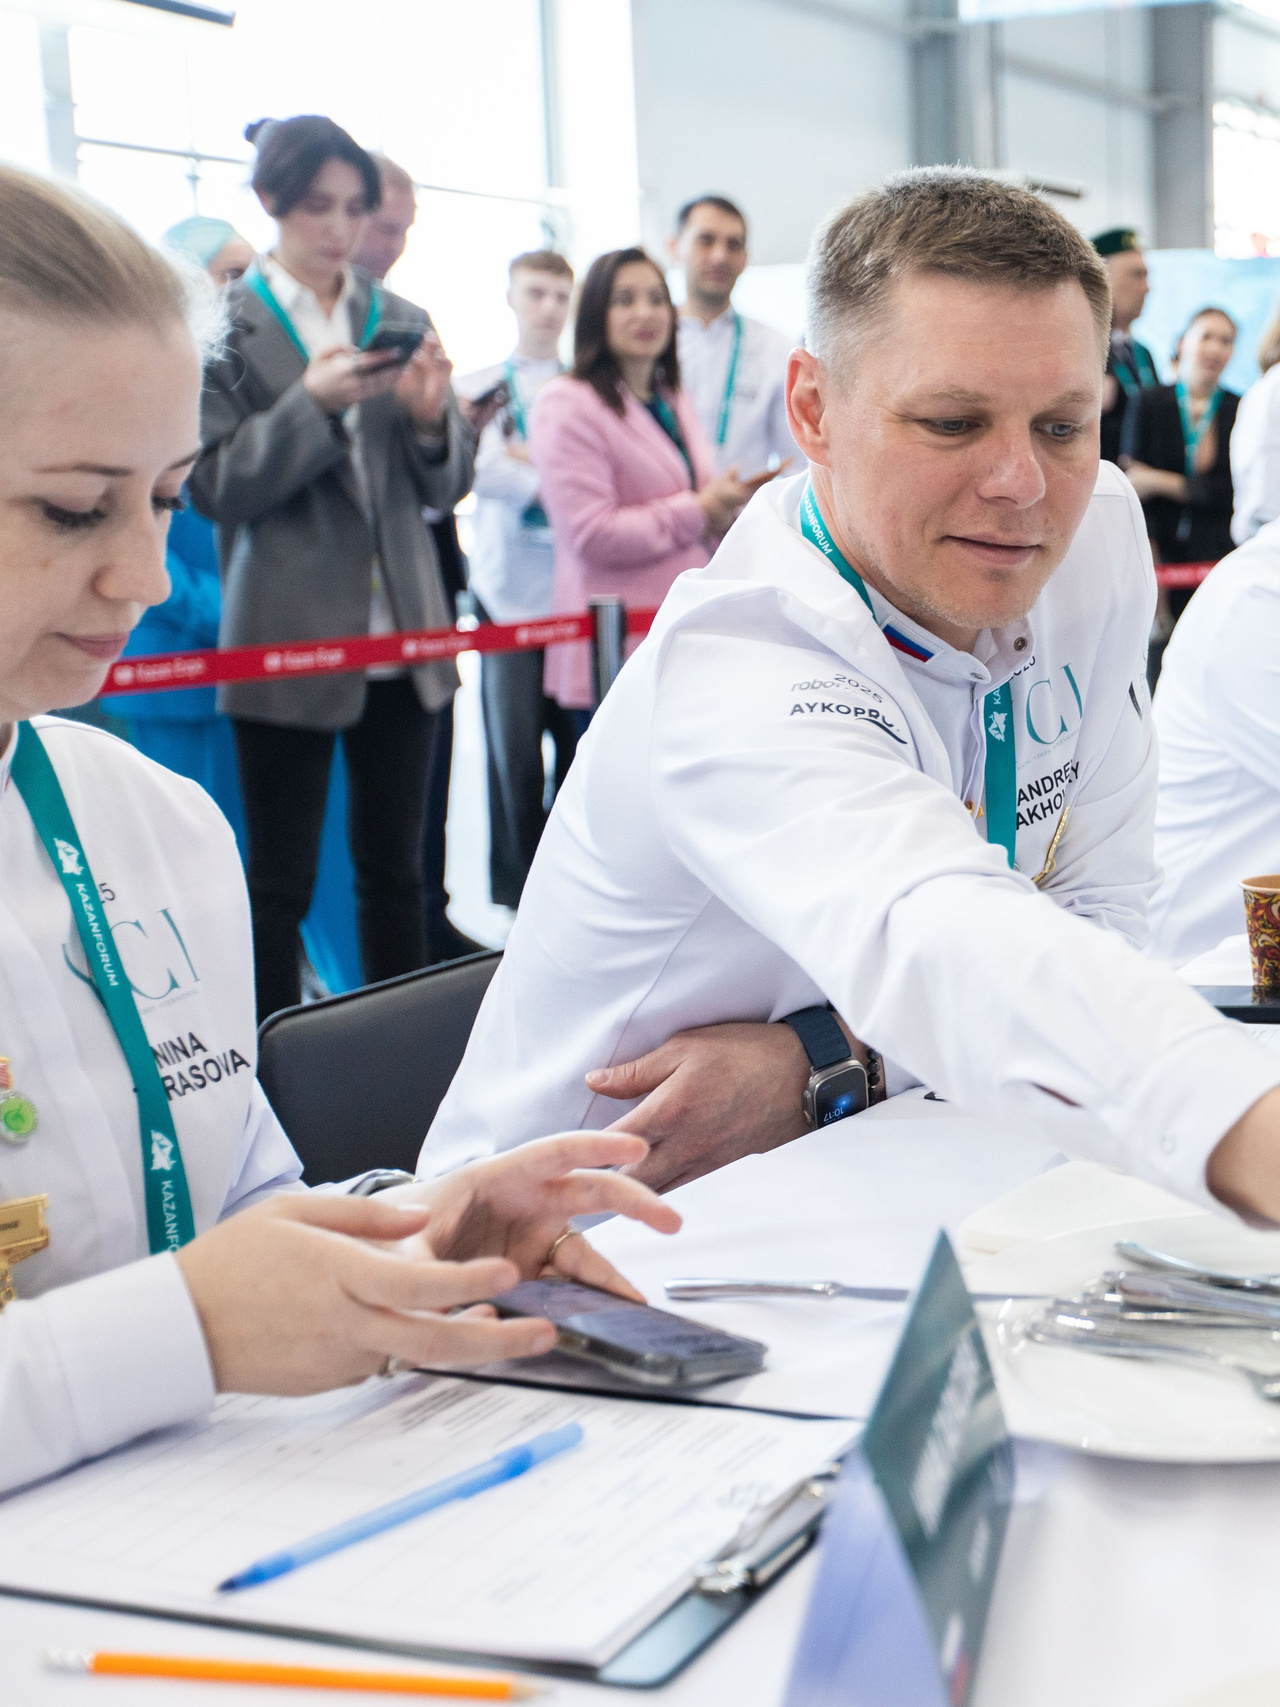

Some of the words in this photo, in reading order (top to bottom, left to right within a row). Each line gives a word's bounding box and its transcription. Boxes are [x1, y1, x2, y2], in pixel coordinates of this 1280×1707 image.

[791, 679, 841, 692] robo
[834, 673, 883, 703] 2025
[76, 883, 119, 987] KAZANFORUM
[162, 1048, 251, 1101] RASOVA
[161, 1180, 180, 1253] KAZANFO
